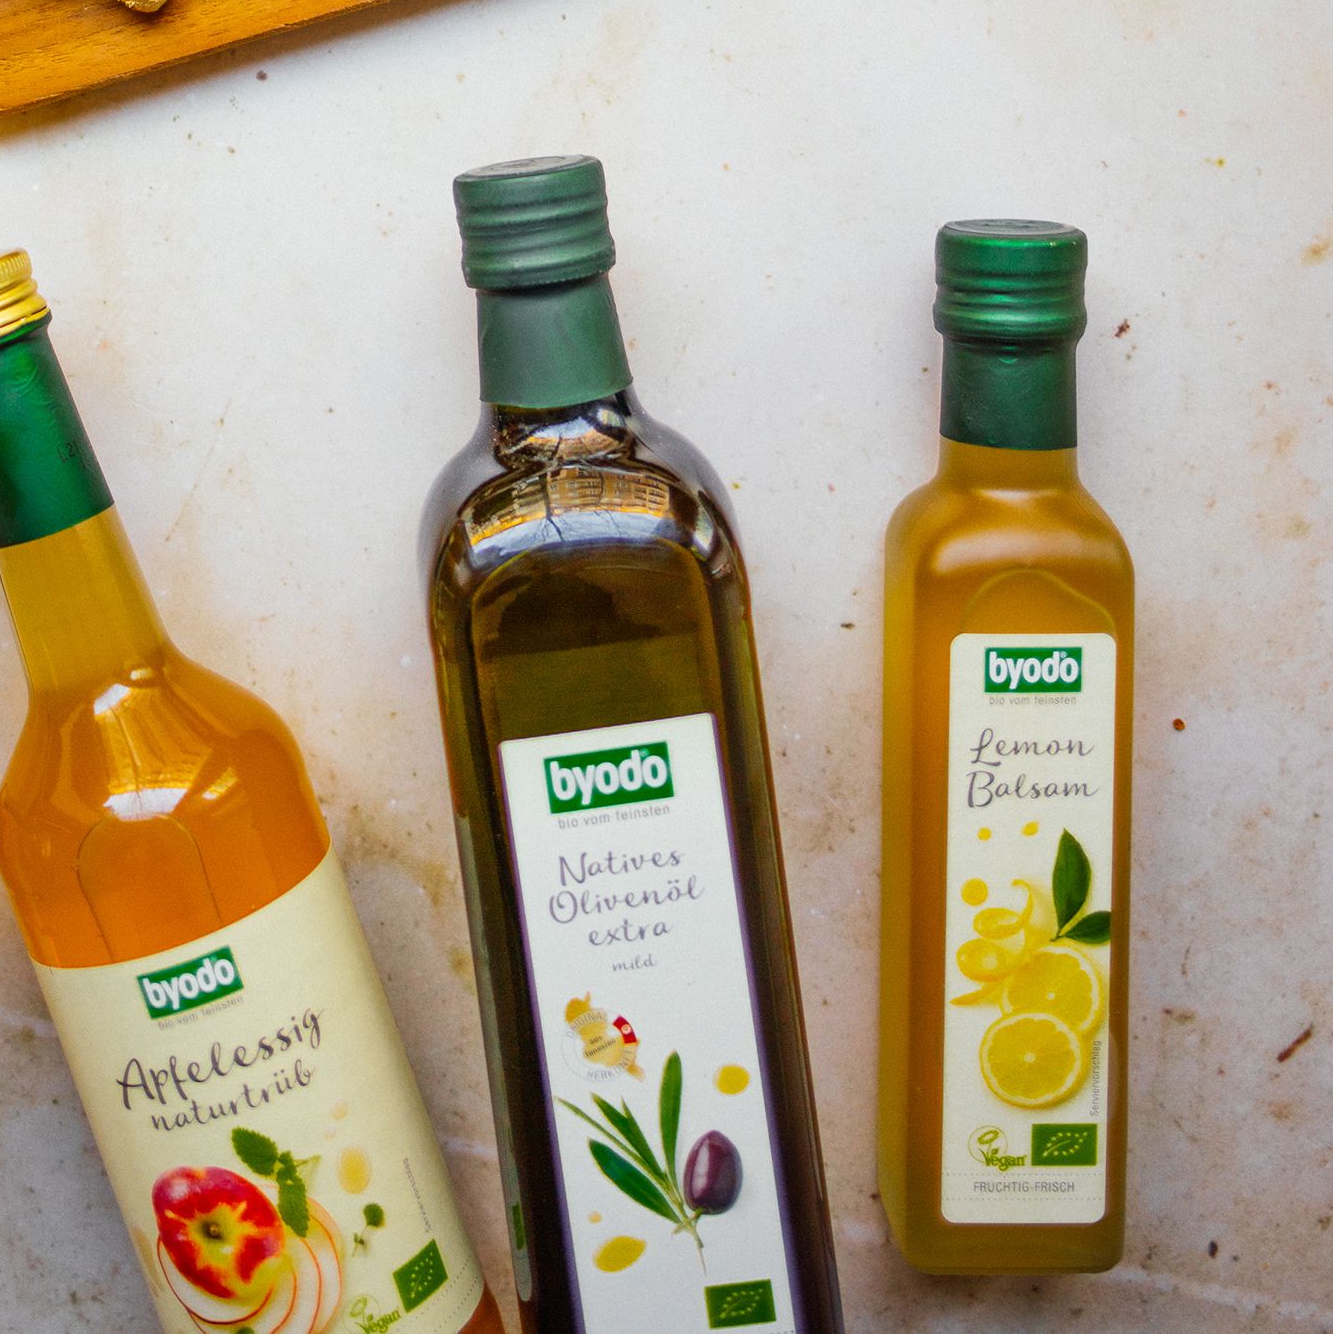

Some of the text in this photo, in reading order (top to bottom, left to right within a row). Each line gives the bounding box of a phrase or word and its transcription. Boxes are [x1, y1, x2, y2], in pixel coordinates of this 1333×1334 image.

[988, 651, 1079, 690] byodo
[989, 695, 1077, 705] bio vom feinsten
[970, 727, 1095, 767] Lemon
[549, 750, 668, 805] byodo
[966, 770, 1100, 808] Balsam
[558, 803, 671, 829] bio vom feinsten
[558, 849, 685, 886] Natives
[549, 874, 704, 924] Olivenöl
[588, 918, 673, 946] extra
[612, 953, 656, 972] mild
[142, 957, 235, 1010] byodo
[116, 1007, 325, 1110] Apfelessig
[151, 1059, 316, 1131] naturtrüb
[1089, 1040, 1102, 1117] Serviervorschlag
[979, 1147, 1027, 1172] Vegan
[973, 1181, 1075, 1193] FRUCHTIG-FRISCH
